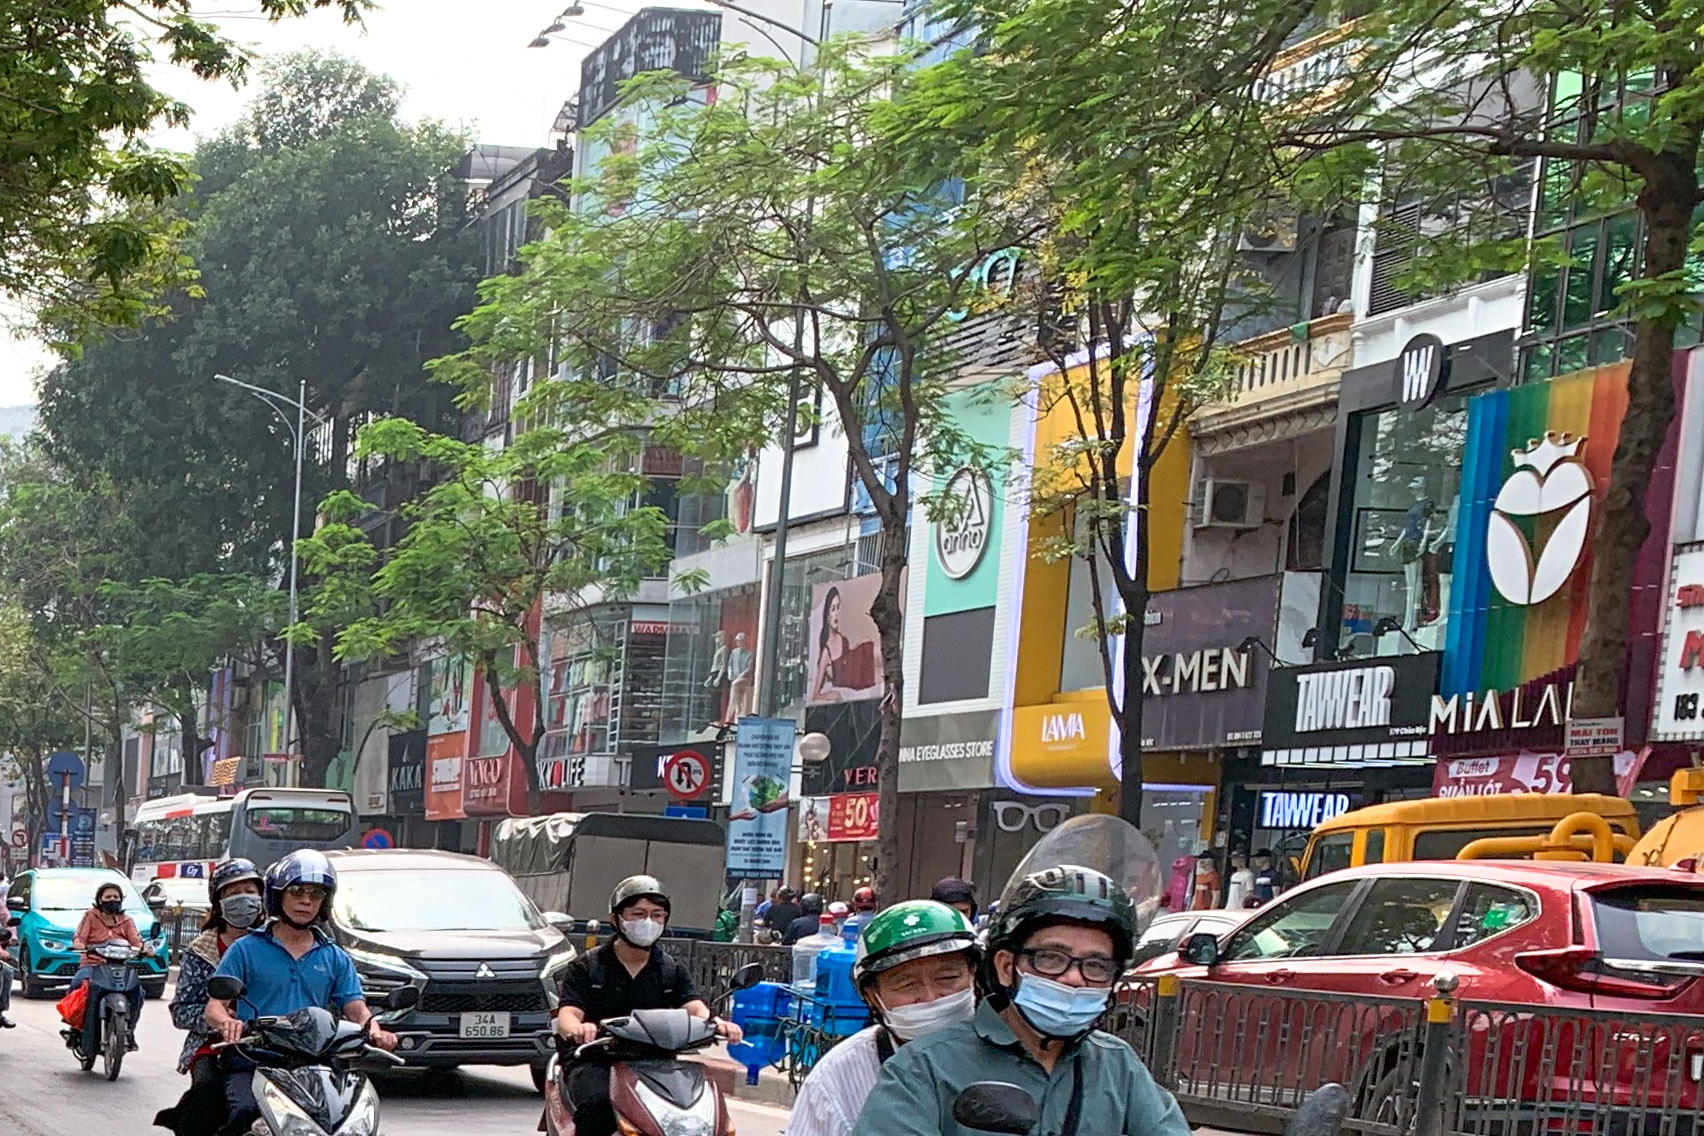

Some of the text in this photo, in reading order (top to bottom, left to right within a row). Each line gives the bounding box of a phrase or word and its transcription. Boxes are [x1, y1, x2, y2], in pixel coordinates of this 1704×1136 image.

[1141, 648, 1250, 695] X-MEN
[1042, 712, 1085, 742] LAMIA
[916, 742, 965, 761] EYEGLASSES
[965, 740, 994, 758] STORE
[1456, 758, 1490, 775] Buffet
[391, 764, 422, 791] KAKA
[475, 1014, 496, 1024] 34A
[465, 1026, 504, 1036] 650.86
